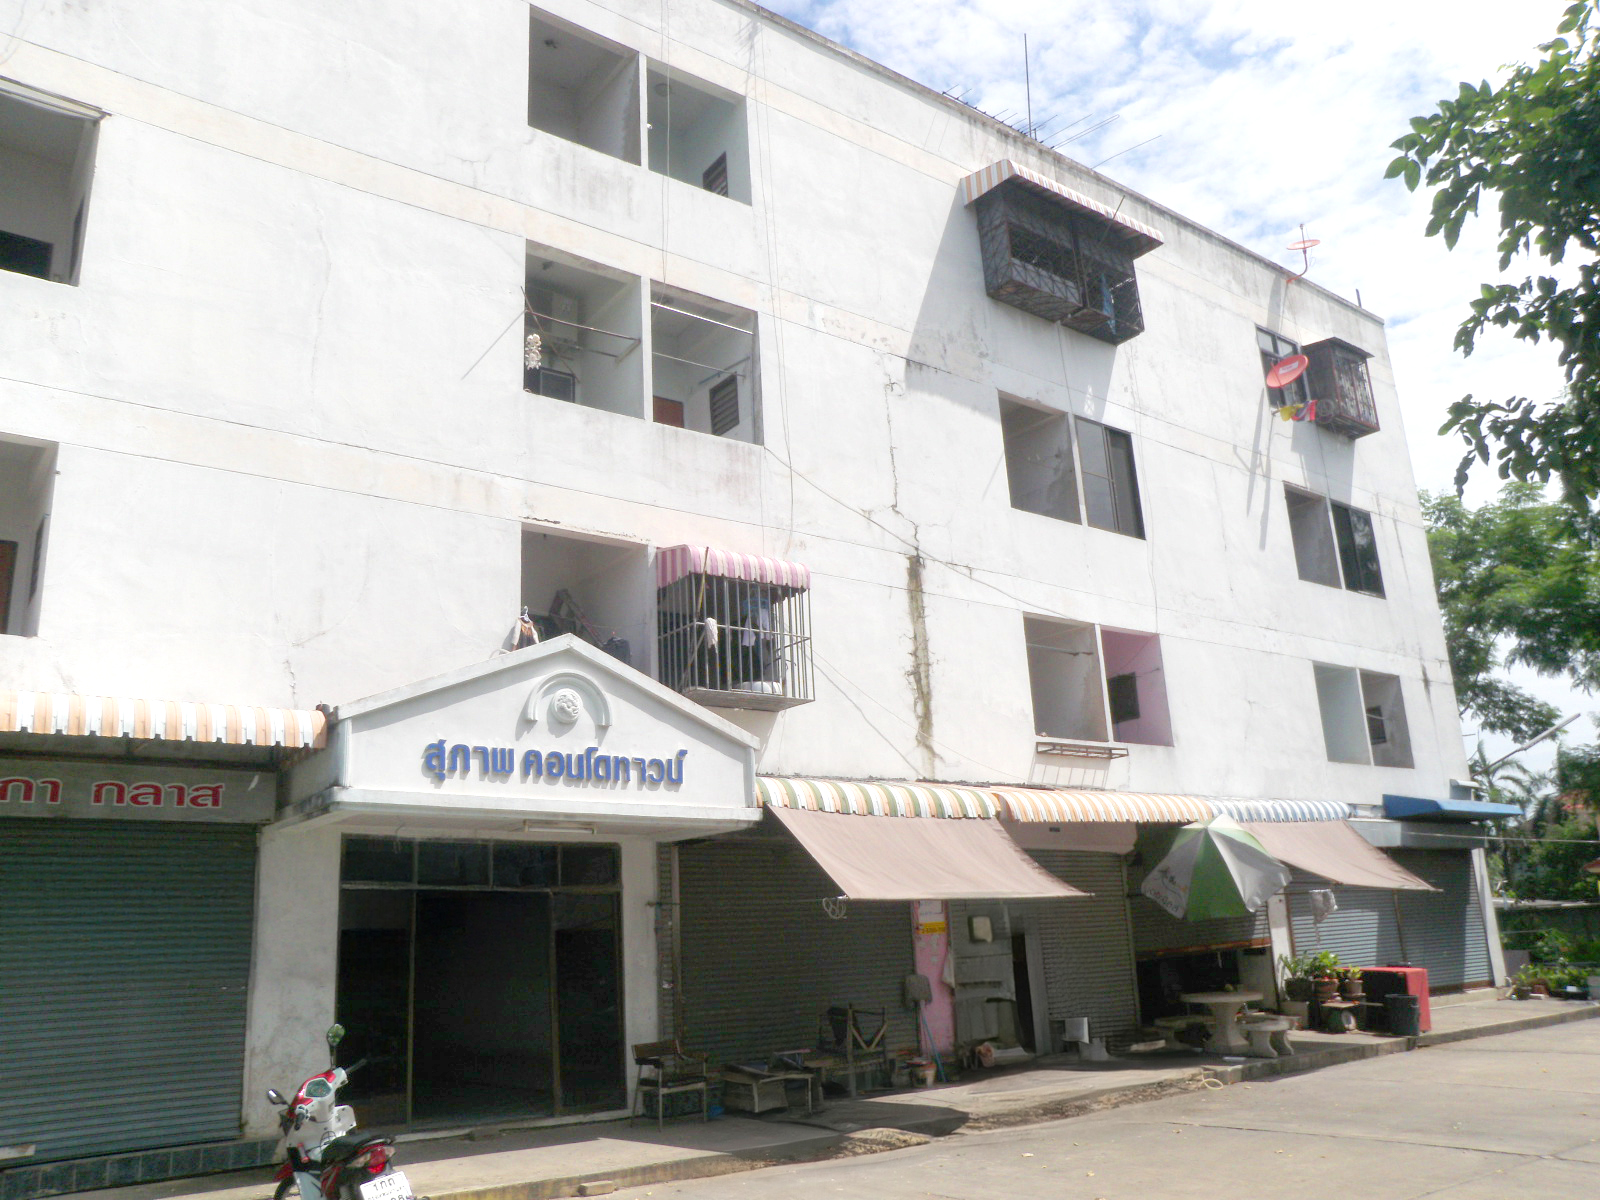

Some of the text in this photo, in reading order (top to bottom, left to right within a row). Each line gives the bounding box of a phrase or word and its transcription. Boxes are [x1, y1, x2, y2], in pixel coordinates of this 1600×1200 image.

[423, 739, 689, 785] สุภาพ คอนโดทาวน์
[91, 779, 226, 808] กลาส
